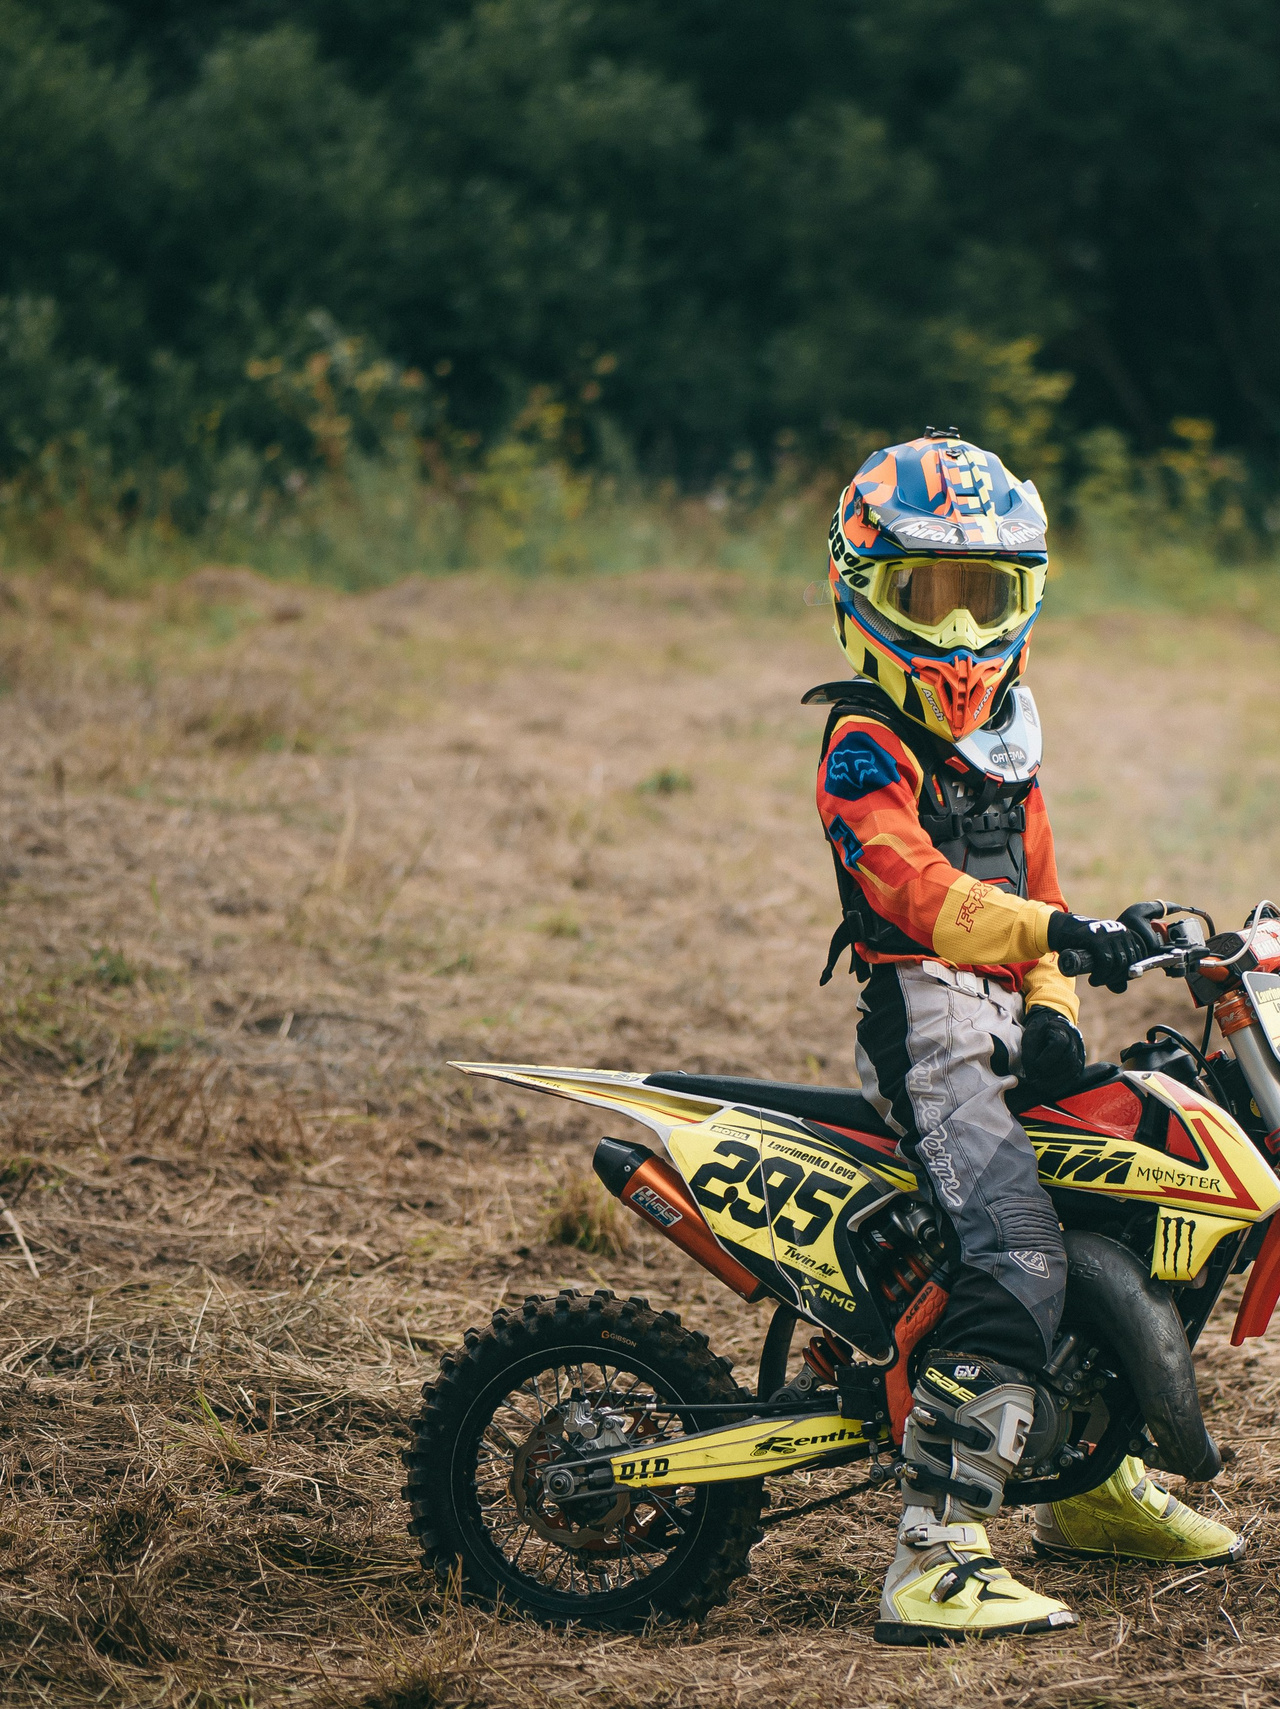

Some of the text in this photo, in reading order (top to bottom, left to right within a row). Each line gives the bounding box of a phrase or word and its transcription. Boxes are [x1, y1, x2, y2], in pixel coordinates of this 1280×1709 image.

[897, 521, 958, 544] Airoh
[922, 688, 944, 721] Airoh
[973, 686, 994, 720] Airoh
[991, 752, 1026, 764] ORTEMA
[919, 1095, 946, 1132] Lee
[711, 1126, 750, 1140] MOTUL
[767, 1141, 857, 1181] Lavrinenko Leva
[631, 1187, 682, 1226] HGS
[689, 1140, 853, 1247] 295
[784, 1245, 816, 1267] Twin
[815, 1263, 839, 1277] Air
[820, 1288, 857, 1313] RMG
[610, 1333, 637, 1348] GIBSON
[750, 1429, 866, 1457] Rentha
[620, 1458, 669, 1481] D.I.D
